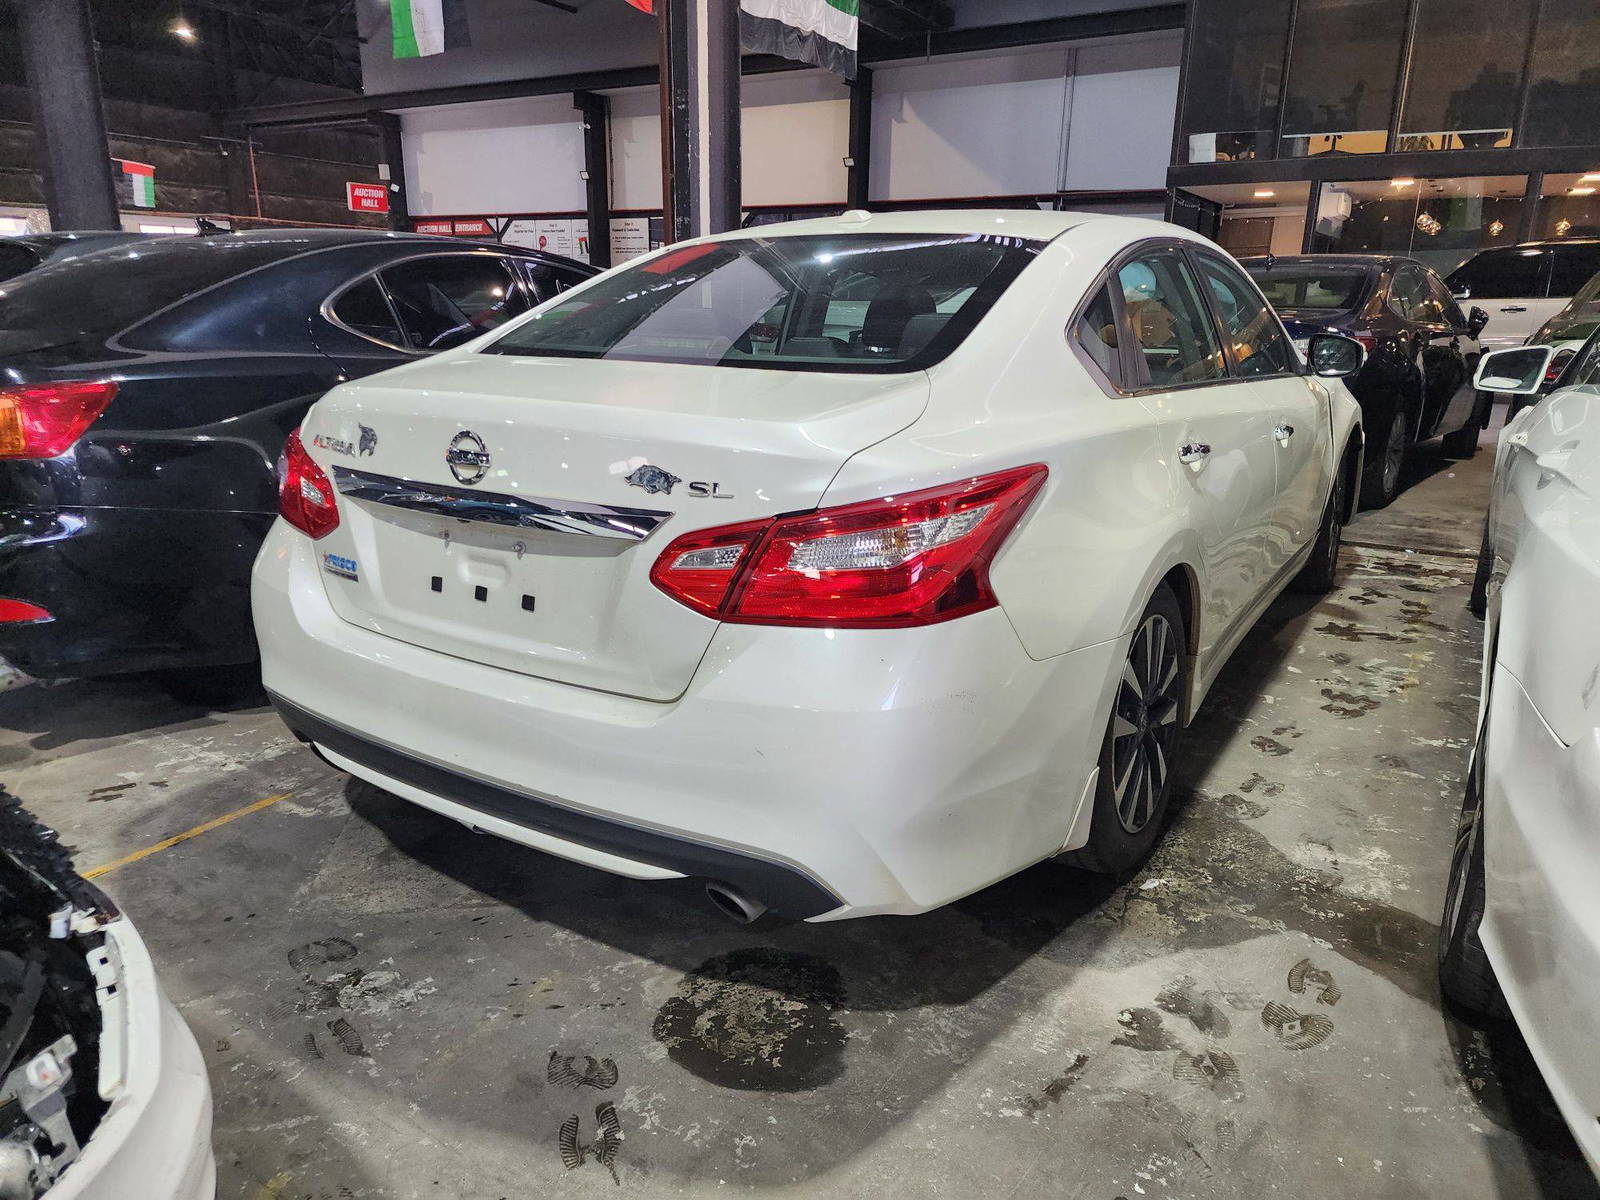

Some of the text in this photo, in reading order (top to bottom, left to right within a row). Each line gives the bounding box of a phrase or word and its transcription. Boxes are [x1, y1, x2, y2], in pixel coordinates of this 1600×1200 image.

[354, 187, 384, 198] AUCTION
[361, 198, 379, 208] HALL
[438, 224, 452, 233] HALL
[688, 481, 735, 499] SL
